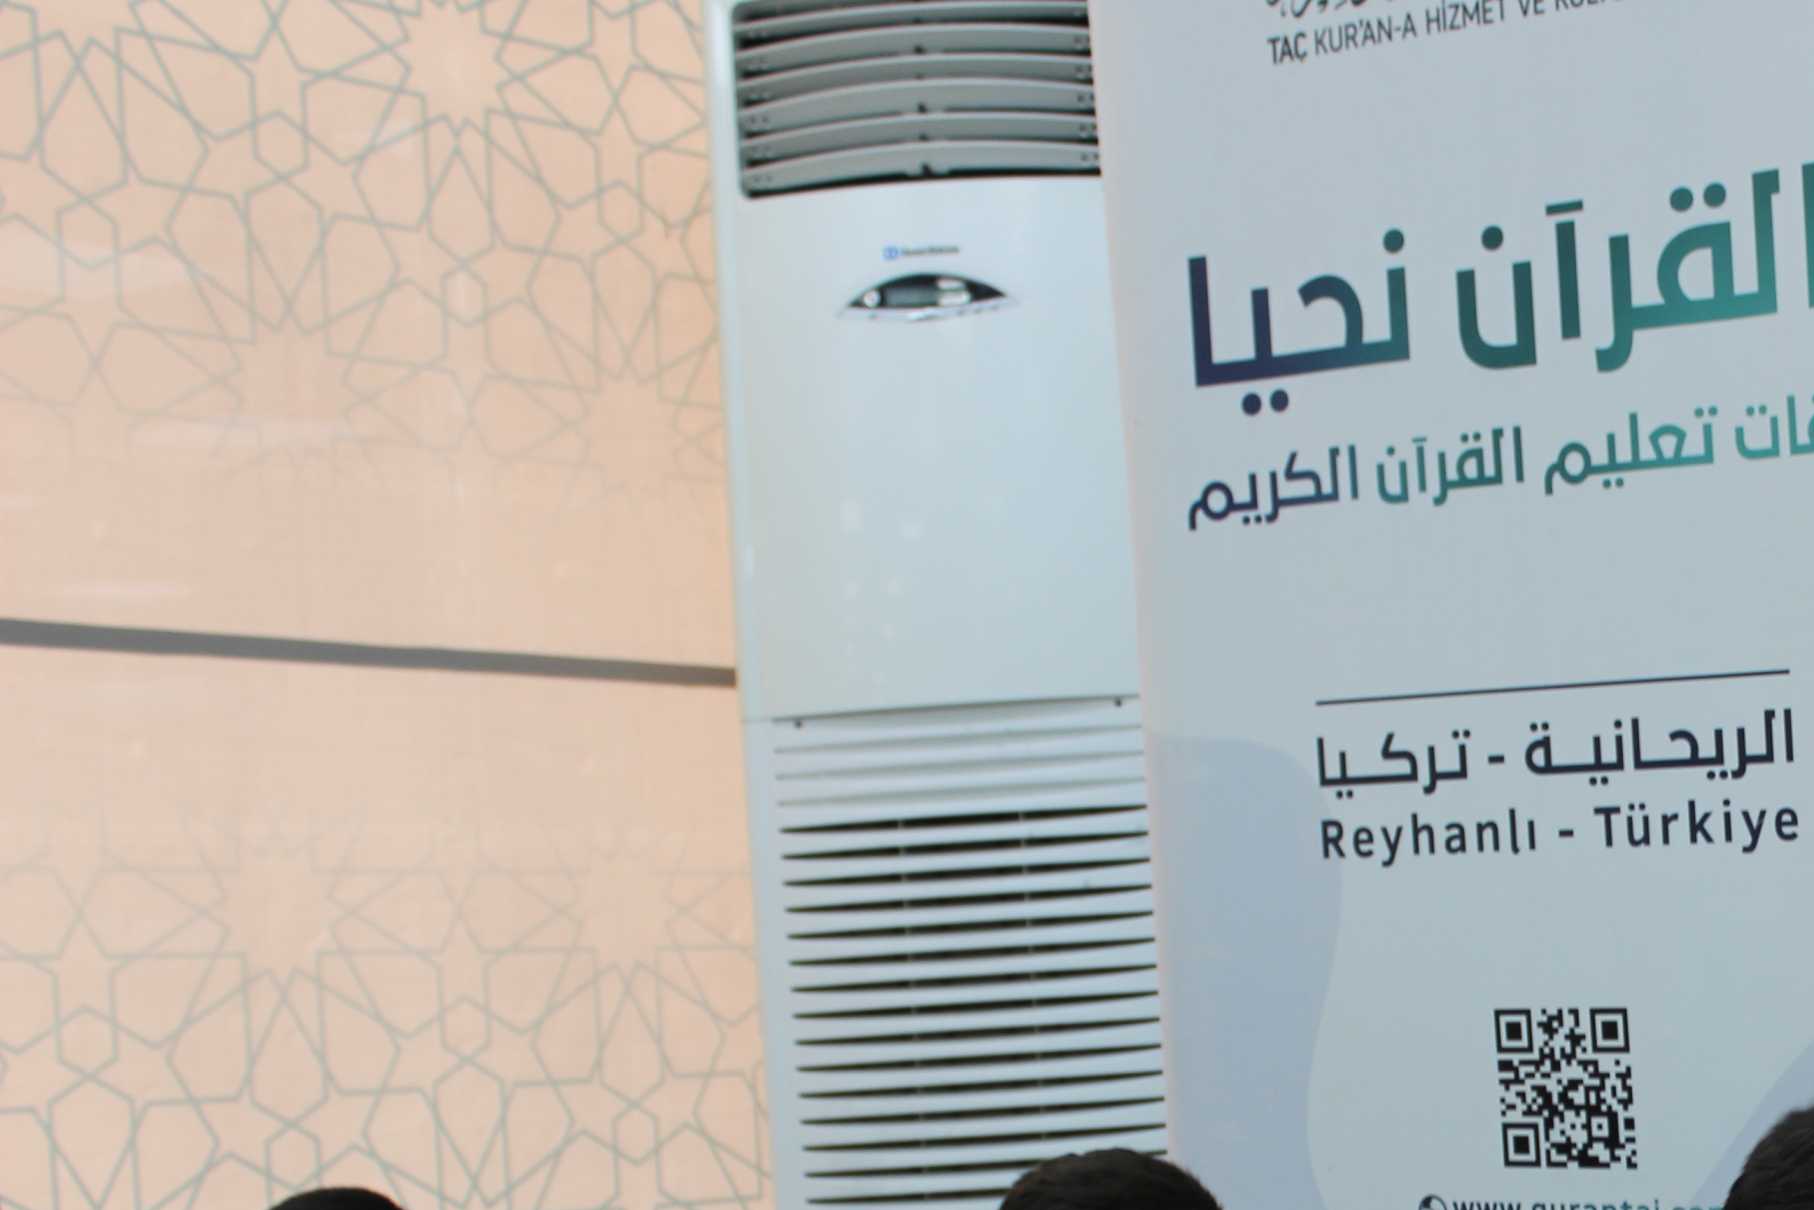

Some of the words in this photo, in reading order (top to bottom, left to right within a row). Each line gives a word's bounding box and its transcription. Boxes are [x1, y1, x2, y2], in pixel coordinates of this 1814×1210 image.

[1267, 31, 1308, 65] TAÇ
[1187, 227, 1412, 417] نحيا
[1187, 443, 1360, 532] الكريم
[1375, 425, 1526, 507] القرآن
[1542, 405, 1720, 496] تعليم
[1315, 728, 1472, 800] تركيا
[1524, 707, 1796, 787] الريحانية
[1320, 807, 1537, 868] Reyhanlı
[1592, 798, 1800, 854] Türkiye
